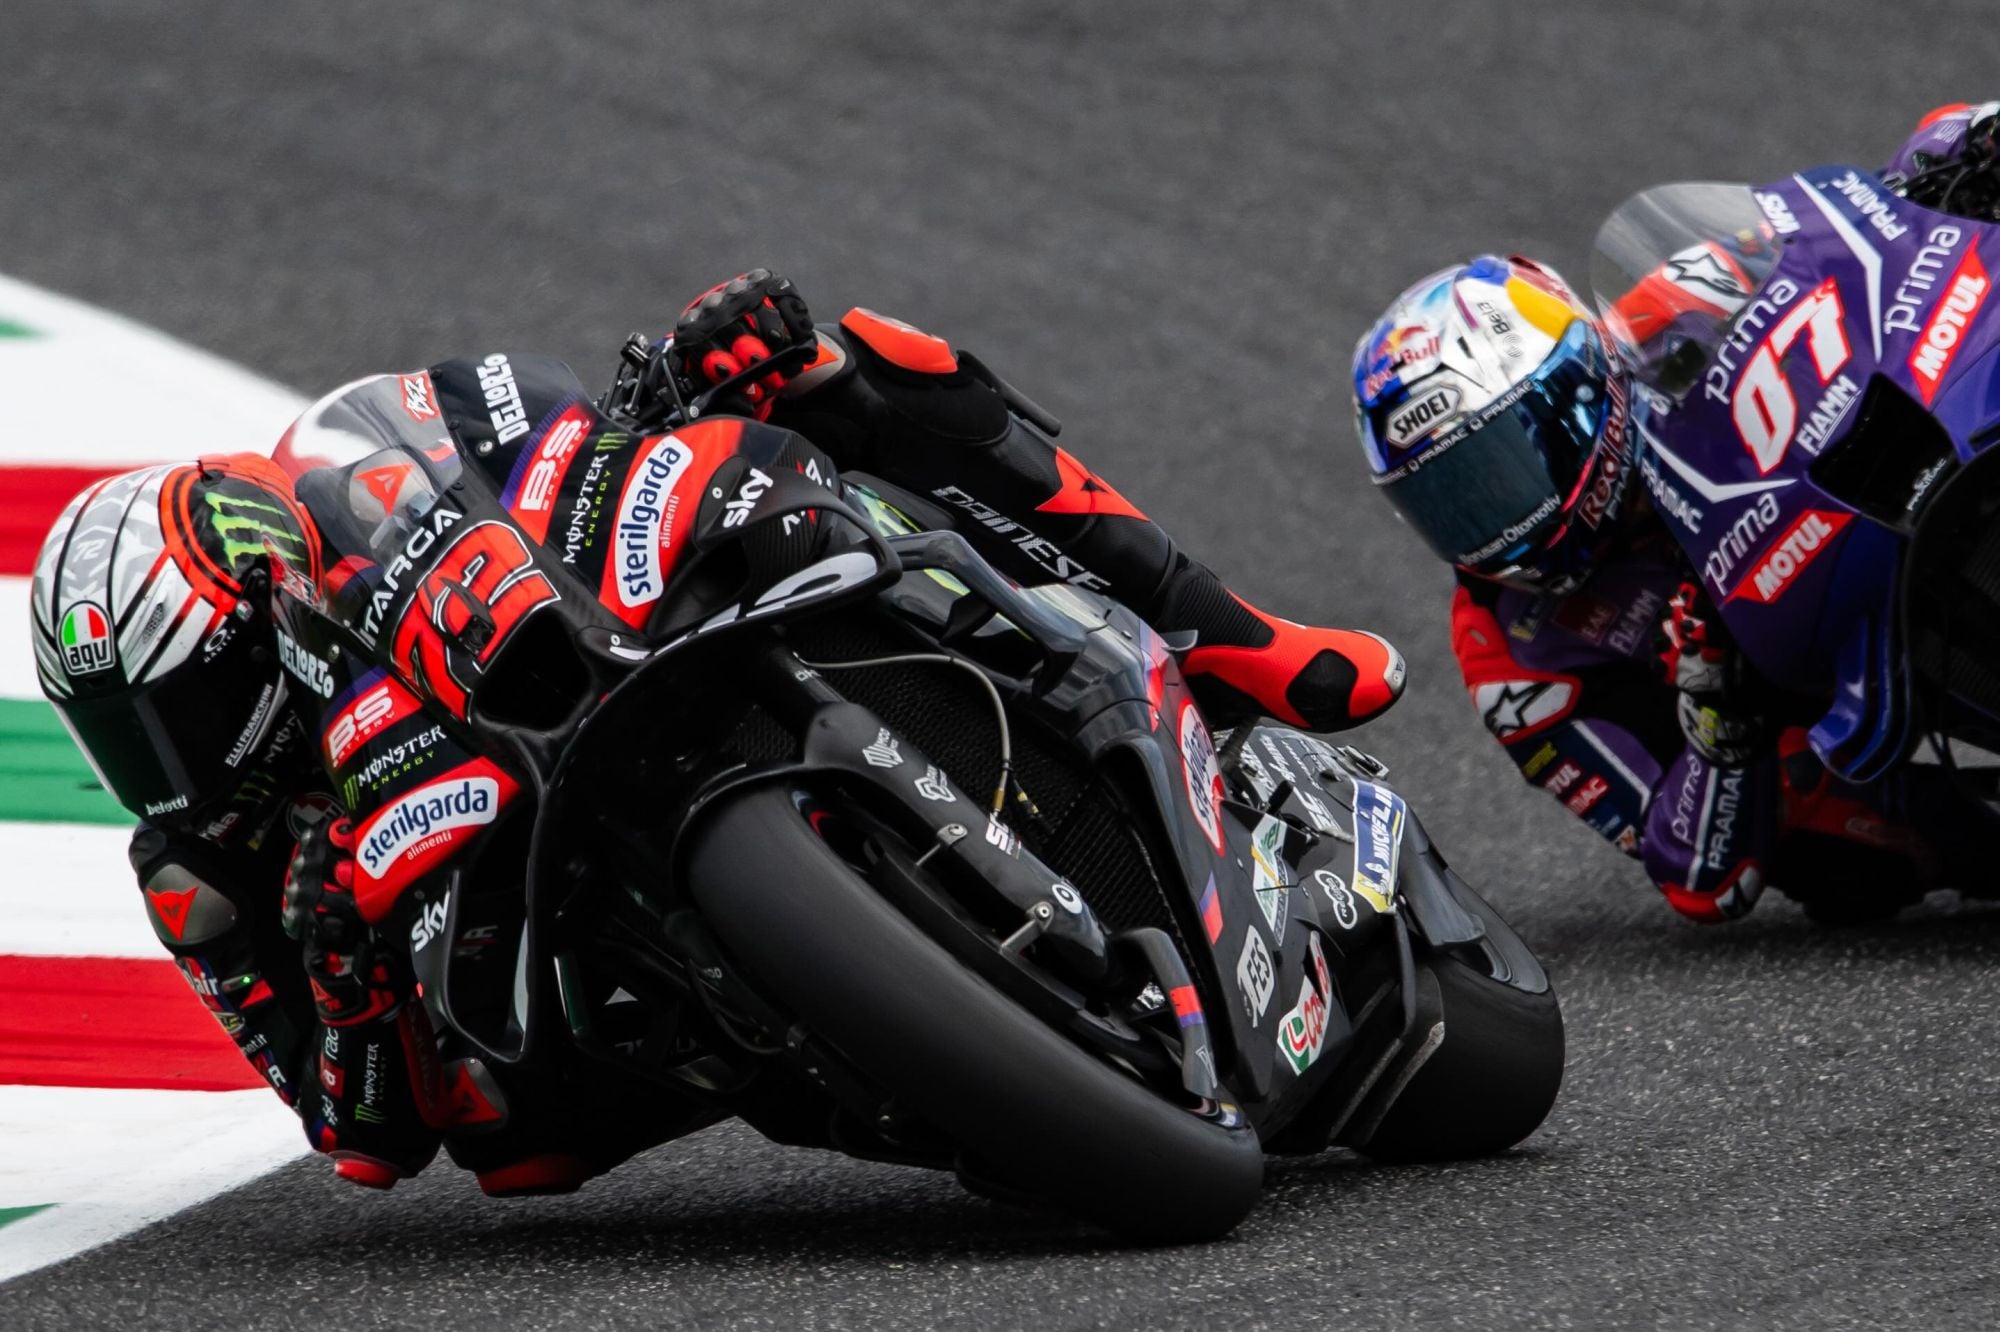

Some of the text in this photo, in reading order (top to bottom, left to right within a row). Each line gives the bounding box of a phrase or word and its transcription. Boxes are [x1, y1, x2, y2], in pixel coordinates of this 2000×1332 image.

[1831, 170, 1909, 242] PRAMAC
[1884, 224, 1962, 335] prima
[1402, 335, 1441, 367] Bull
[1704, 278, 1799, 405] prima
[1912, 273, 1986, 381] MOTUL
[1731, 275, 1852, 478] 07
[1392, 392, 1450, 440] SHOEI
[1795, 373, 1859, 456] FIAMM
[520, 419, 582, 511] BS
[723, 467, 774, 528] sky
[1578, 441, 1622, 530] Red
[563, 453, 609, 563] MONSTER
[585, 470, 612, 547] ENERGY
[619, 446, 681, 597] sterilgarda
[660, 495, 680, 548] alimenti
[1704, 491, 1781, 597] prima
[1753, 512, 1834, 601] MOTUL
[69, 640, 108, 669] agv
[328, 685, 393, 756] BS
[358, 725, 447, 787] MONSTER
[145, 793, 189, 817] belotti
[371, 751, 434, 791] ENERGY
[363, 781, 489, 869] sterilgarda
[406, 830, 452, 861] alimenti
[411, 887, 451, 952] sky
[364, 1043, 380, 1105] MONSTER
